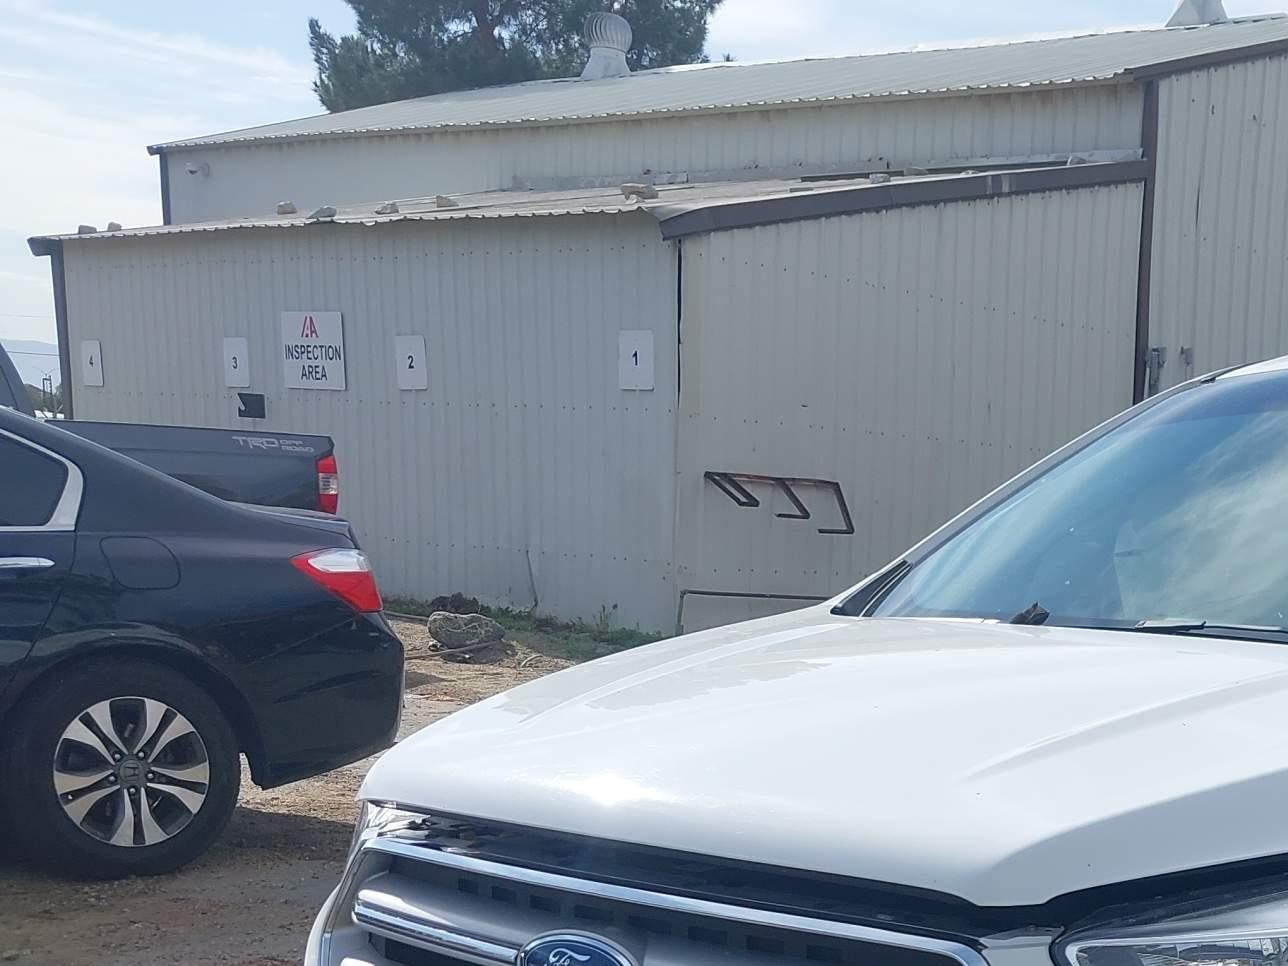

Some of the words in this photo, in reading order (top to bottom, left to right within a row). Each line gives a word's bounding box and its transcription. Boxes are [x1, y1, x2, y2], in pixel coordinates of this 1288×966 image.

[284, 344, 342, 361] INSPECTION
[632, 350, 639, 366] 1
[88, 355, 95, 367] 4
[231, 356, 238, 369] 3
[407, 355, 415, 369] 2
[301, 364, 328, 381] AREA
[231, 435, 280, 449] TRD
